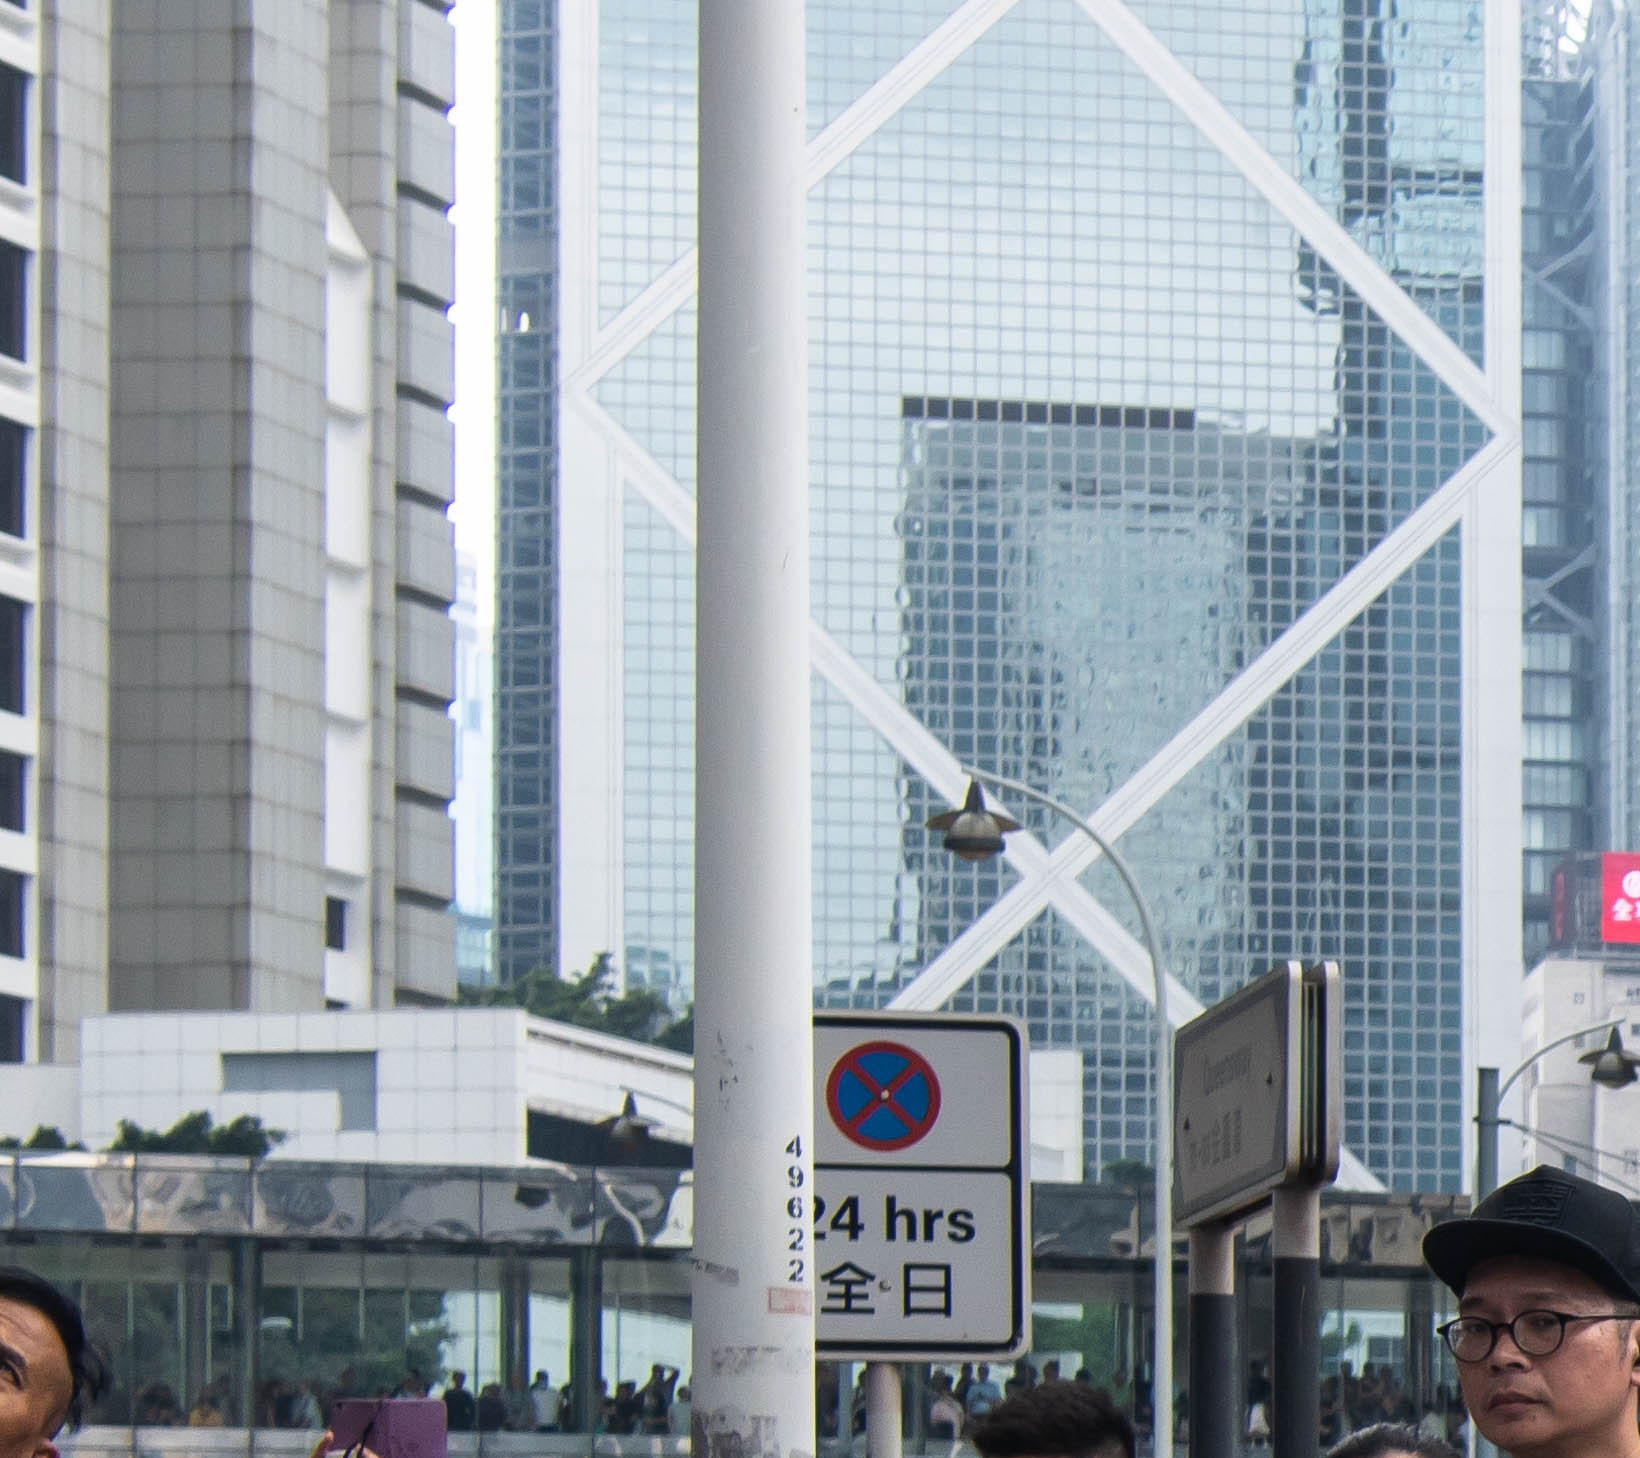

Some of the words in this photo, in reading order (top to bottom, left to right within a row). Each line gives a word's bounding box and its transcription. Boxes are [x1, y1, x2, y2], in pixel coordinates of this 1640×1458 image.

[785, 1134, 804, 1283] 49622
[885, 1195, 976, 1243] hrs
[820, 1261, 951, 1319] 全日
